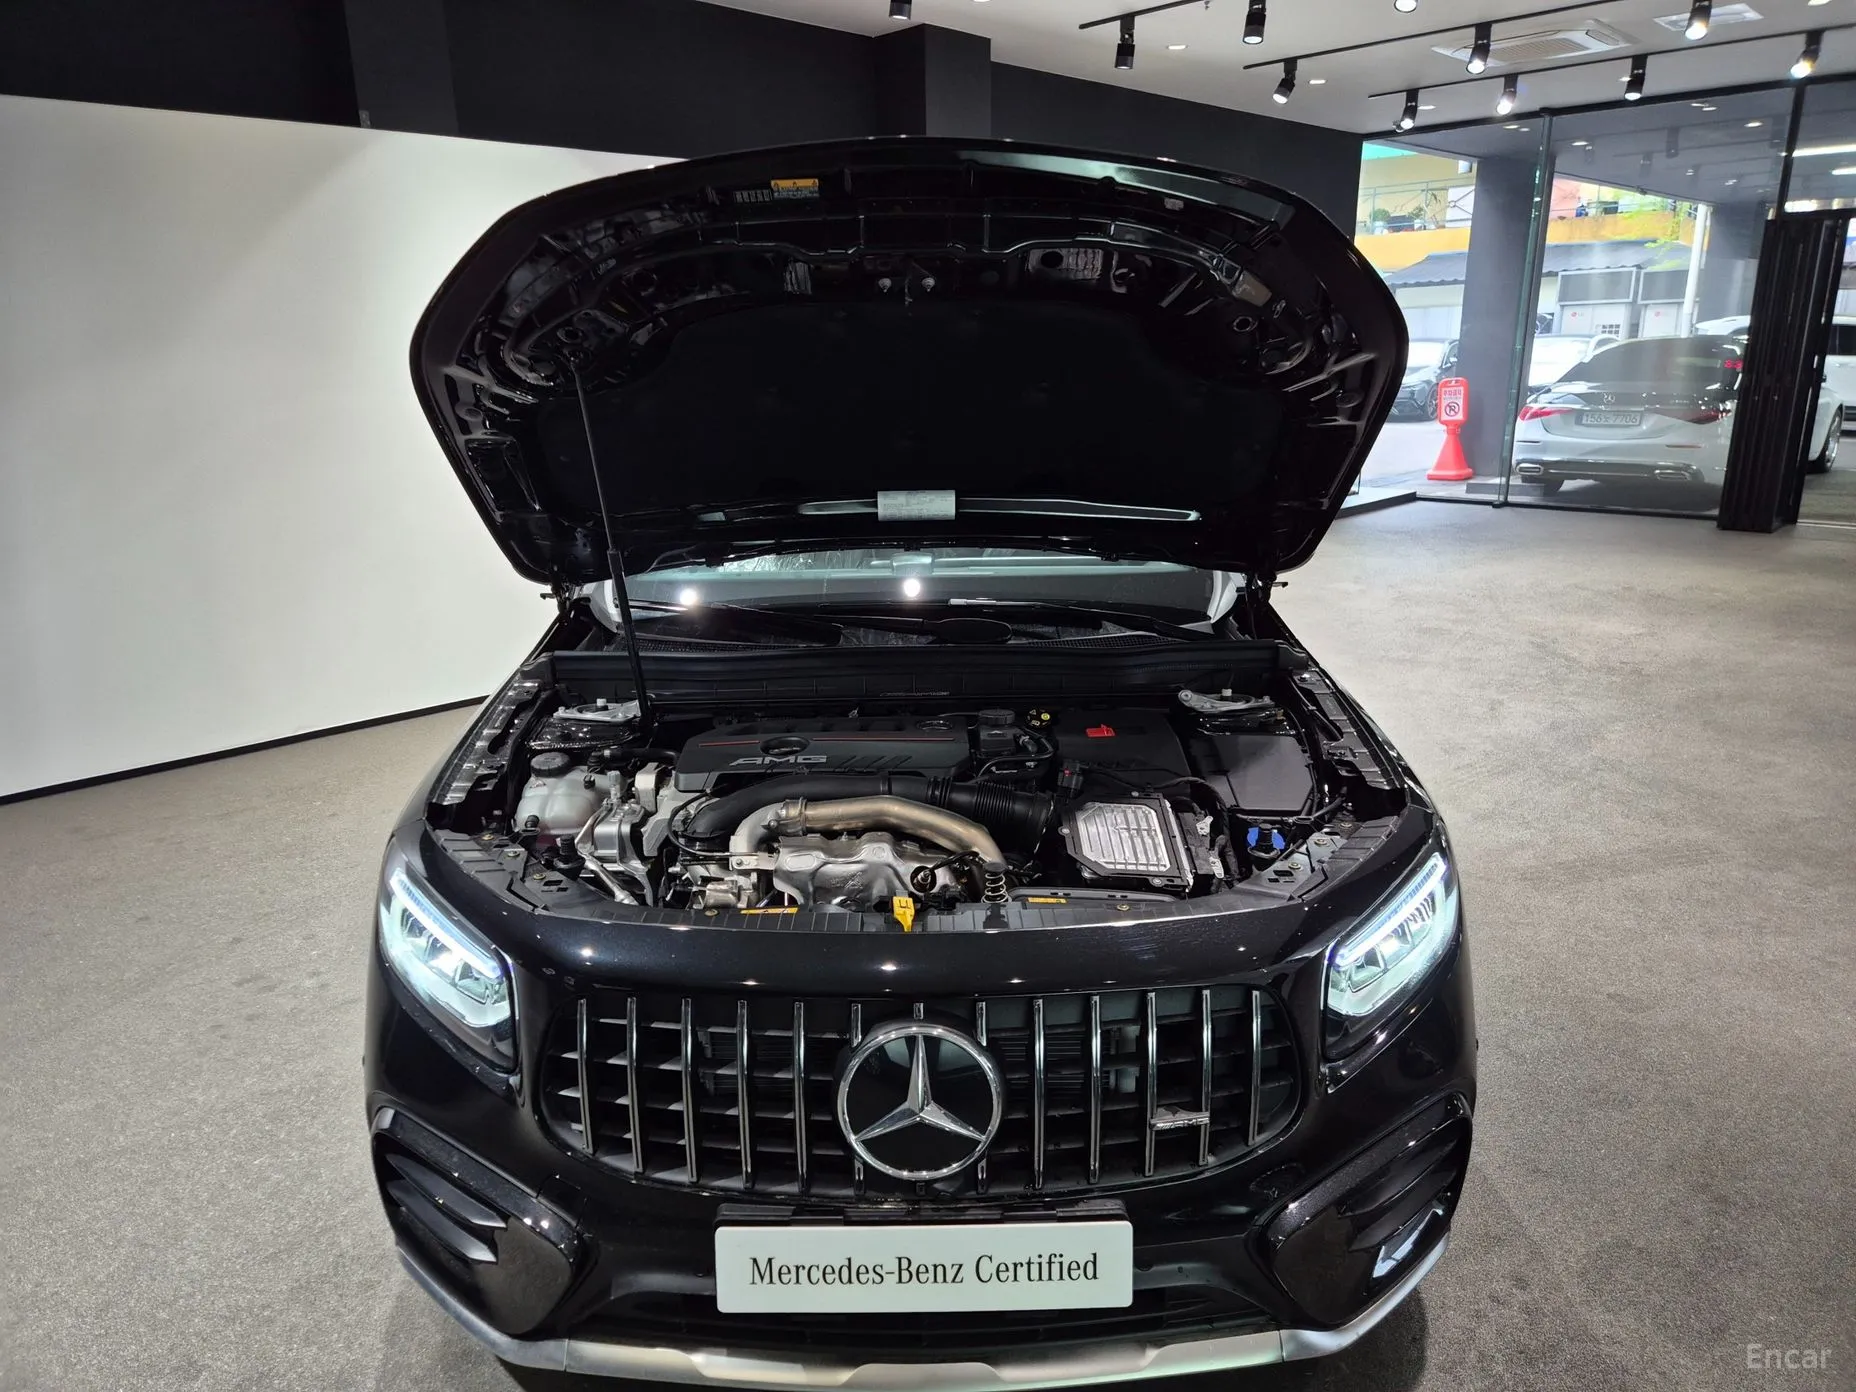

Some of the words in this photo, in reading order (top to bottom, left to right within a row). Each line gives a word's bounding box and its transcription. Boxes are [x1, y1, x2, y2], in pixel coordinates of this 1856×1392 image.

[1613, 413, 1638, 424] 7706
[729, 755, 827, 766] AMG
[749, 1255, 965, 1286] Mercedes-Benz
[975, 1252, 1100, 1283] Certified
